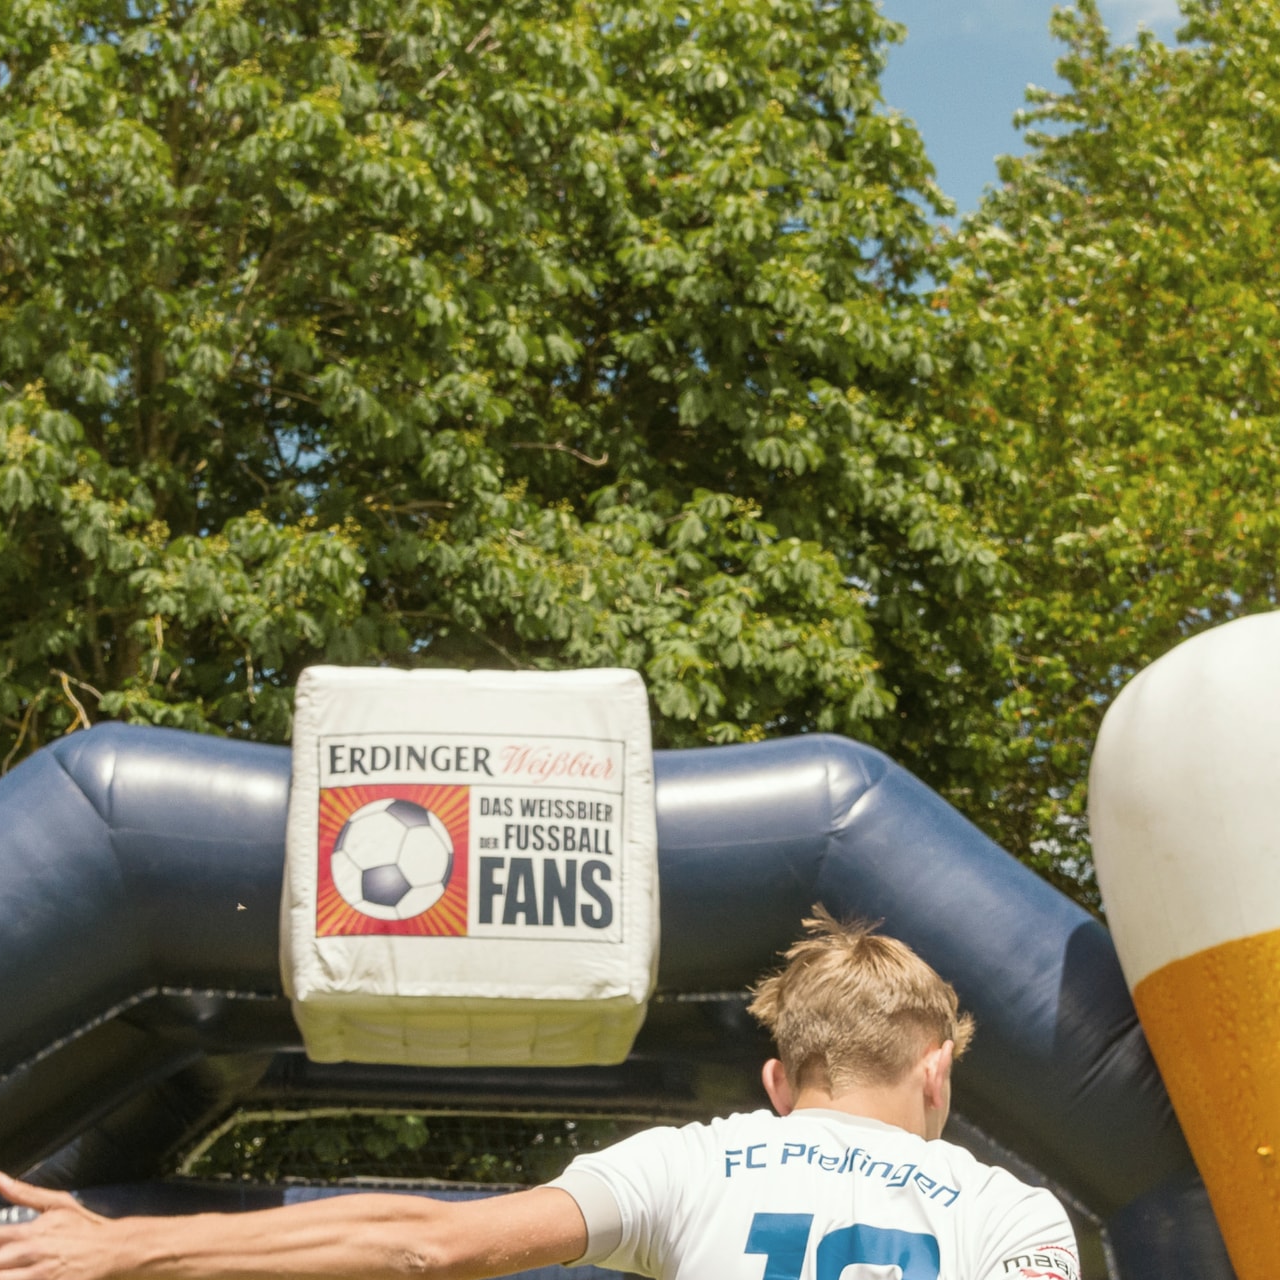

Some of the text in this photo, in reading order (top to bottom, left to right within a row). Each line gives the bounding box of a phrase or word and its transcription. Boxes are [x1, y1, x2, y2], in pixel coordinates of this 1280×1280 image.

[329, 744, 615, 784] ERDINGER Weißbier
[480, 797, 613, 822] DAS WEISSBIER
[479, 824, 613, 855] DER FUSSBALL
[478, 856, 613, 929] FANS
[725, 1144, 767, 1178] FC
